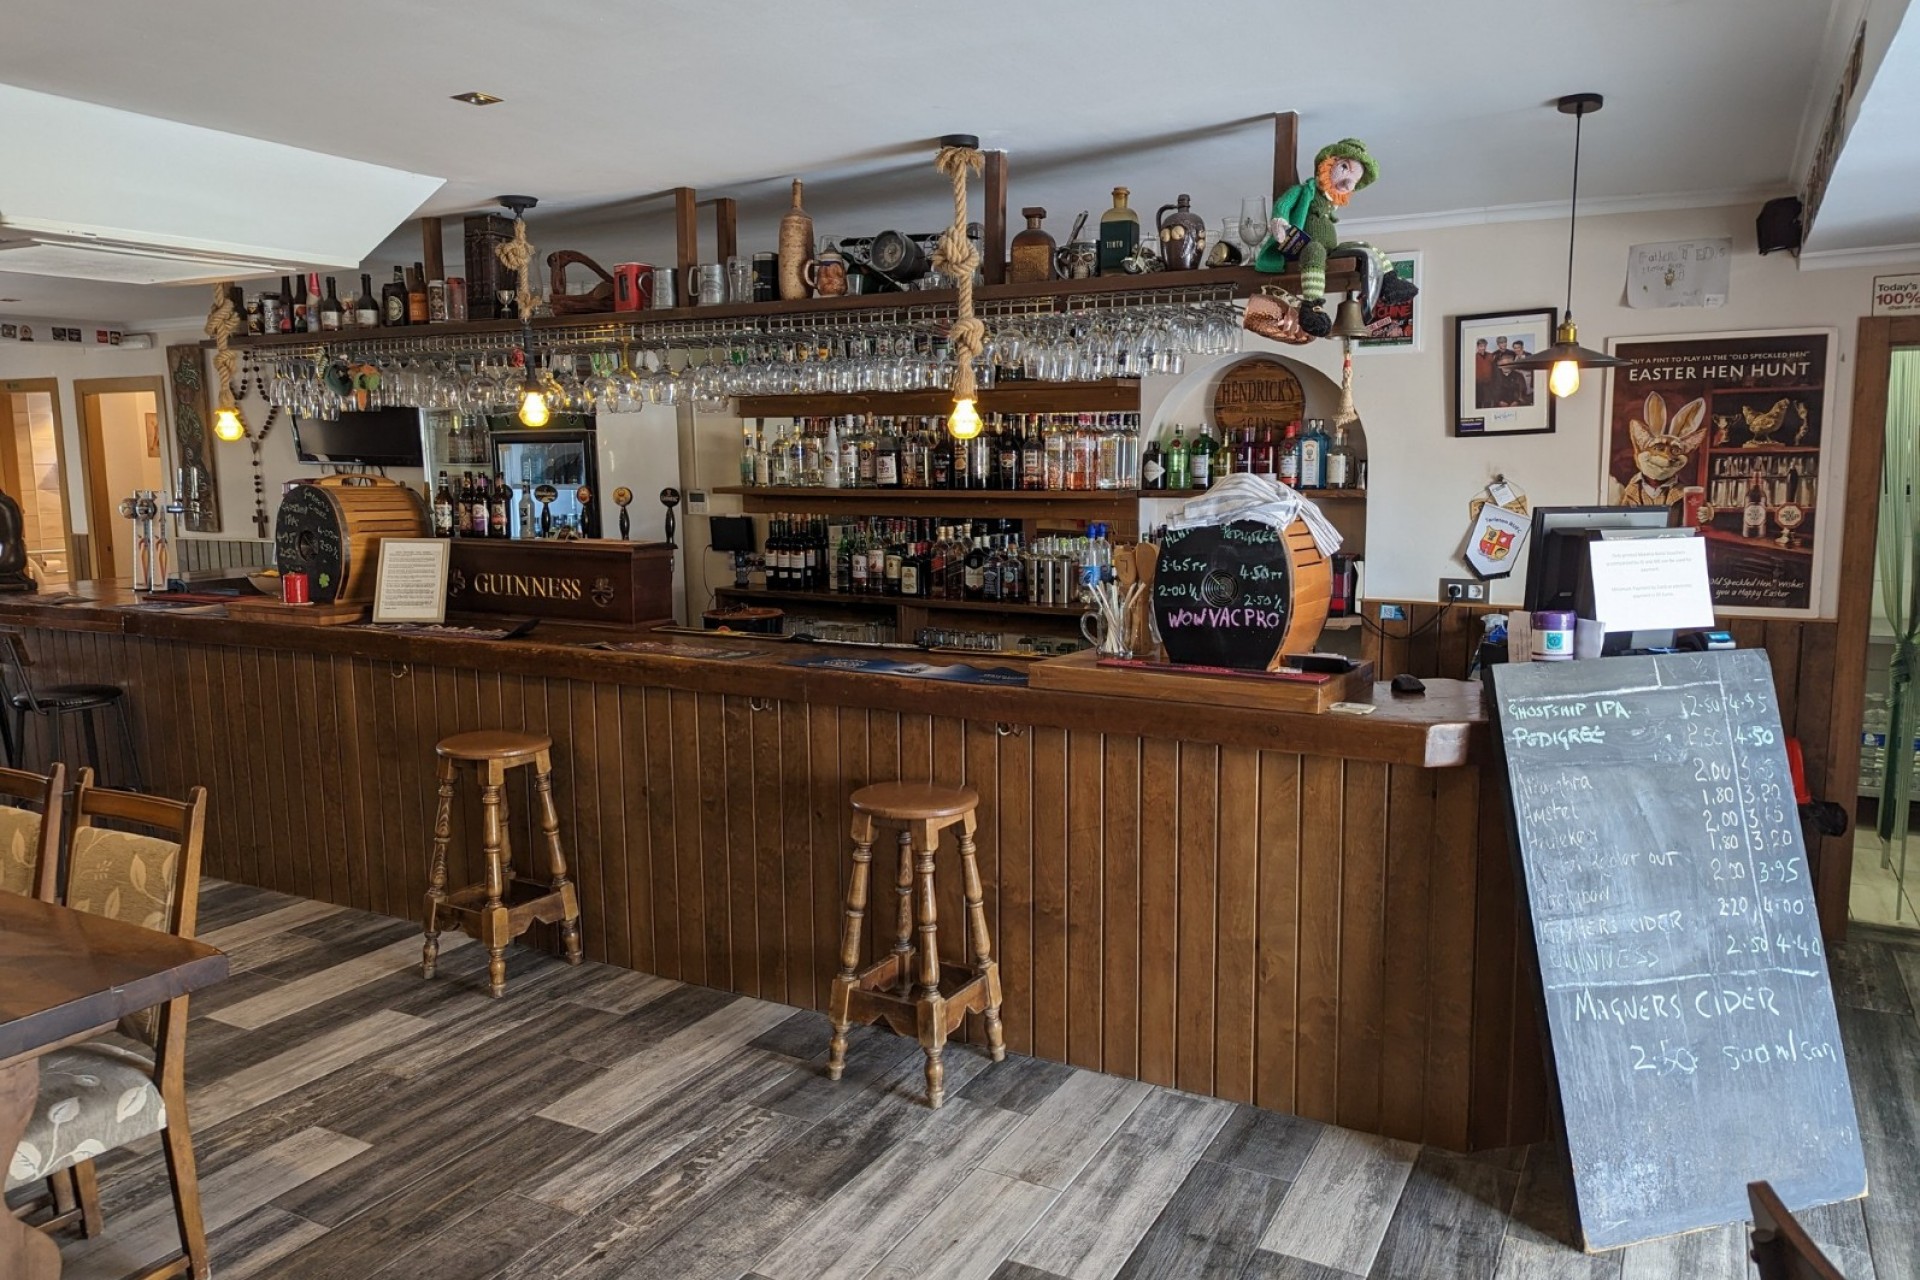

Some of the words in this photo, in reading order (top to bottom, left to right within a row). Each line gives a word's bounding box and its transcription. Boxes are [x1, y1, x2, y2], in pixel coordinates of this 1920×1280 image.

[1878, 282, 1917, 291] Today's
[1749, 351, 1788, 360] SPECKLED
[1629, 366, 1697, 382] EASTER
[1702, 364, 1744, 379] HEN
[1751, 361, 1811, 377] HUNT
[1222, 377, 1296, 403] HENDRICK'S
[474, 574, 582, 600] GUINNESS
[1723, 577, 1757, 588] Speckled
[1715, 589, 1731, 599] you
[1738, 588, 1762, 600] Happy
[1762, 588, 1791, 597] Easter
[1734, 725, 1774, 747] 4.50
[1693, 756, 1731, 782] 2.00
[1702, 786, 1734, 806] 1.80
[1702, 809, 1738, 832] 2.00
[1710, 832, 1739, 851] 1.80
[1759, 857, 1800, 883] 3.95
[1763, 895, 1804, 918] 4.00
[1726, 934, 1769, 956] 2.50
[1776, 933, 1821, 958] 4.40
[1575, 987, 1681, 1025] MAGNERS
[1695, 987, 1779, 1018] CIDER
